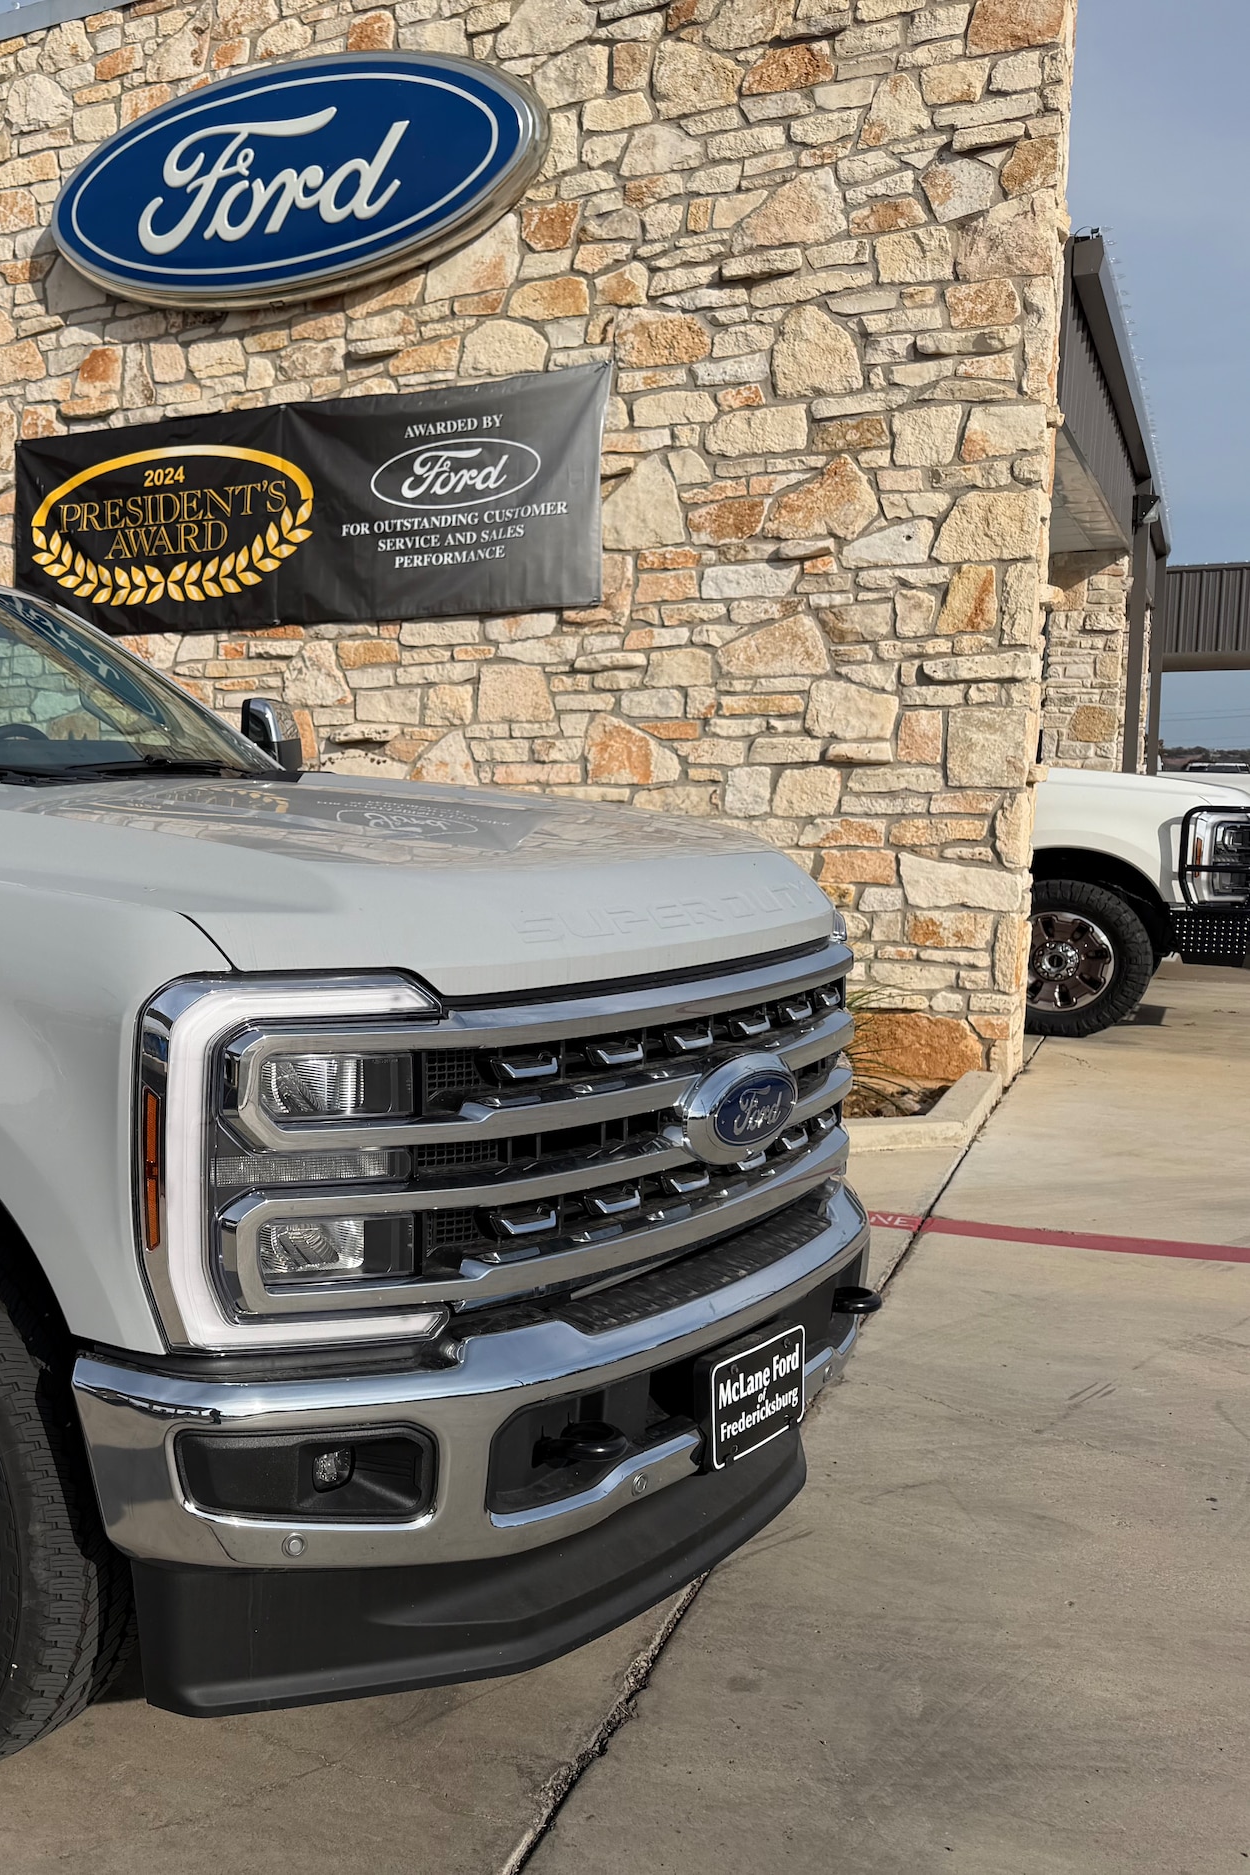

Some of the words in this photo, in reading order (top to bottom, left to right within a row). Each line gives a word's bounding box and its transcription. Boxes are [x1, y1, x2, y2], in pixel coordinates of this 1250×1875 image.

[137, 106, 410, 256] Ford
[404, 417, 478, 438] AWARDED
[482, 414, 503, 429] BY
[143, 466, 185, 487] 2024
[401, 448, 509, 498] Ford
[59, 480, 287, 533] PRESIDENT'S
[341, 523, 370, 537] FOR
[374, 512, 479, 534] OUTSTANDING
[483, 501, 568, 523] CUSTOMER
[104, 521, 228, 559] AWARD
[377, 534, 440, 552] SERVICE
[444, 531, 477, 547] AND
[480, 524, 525, 543] SALES
[394, 546, 506, 569] PERFORMANCE
[512, 899, 723, 944] SUPER
[720, 880, 814, 919] DUTY
[733, 1085, 783, 1136] Ford
[718, 1367, 771, 1410] McLane
[772, 1343, 800, 1382] Ford
[757, 1387, 767, 1403] of
[720, 1387, 798, 1442] Fredericksburg
